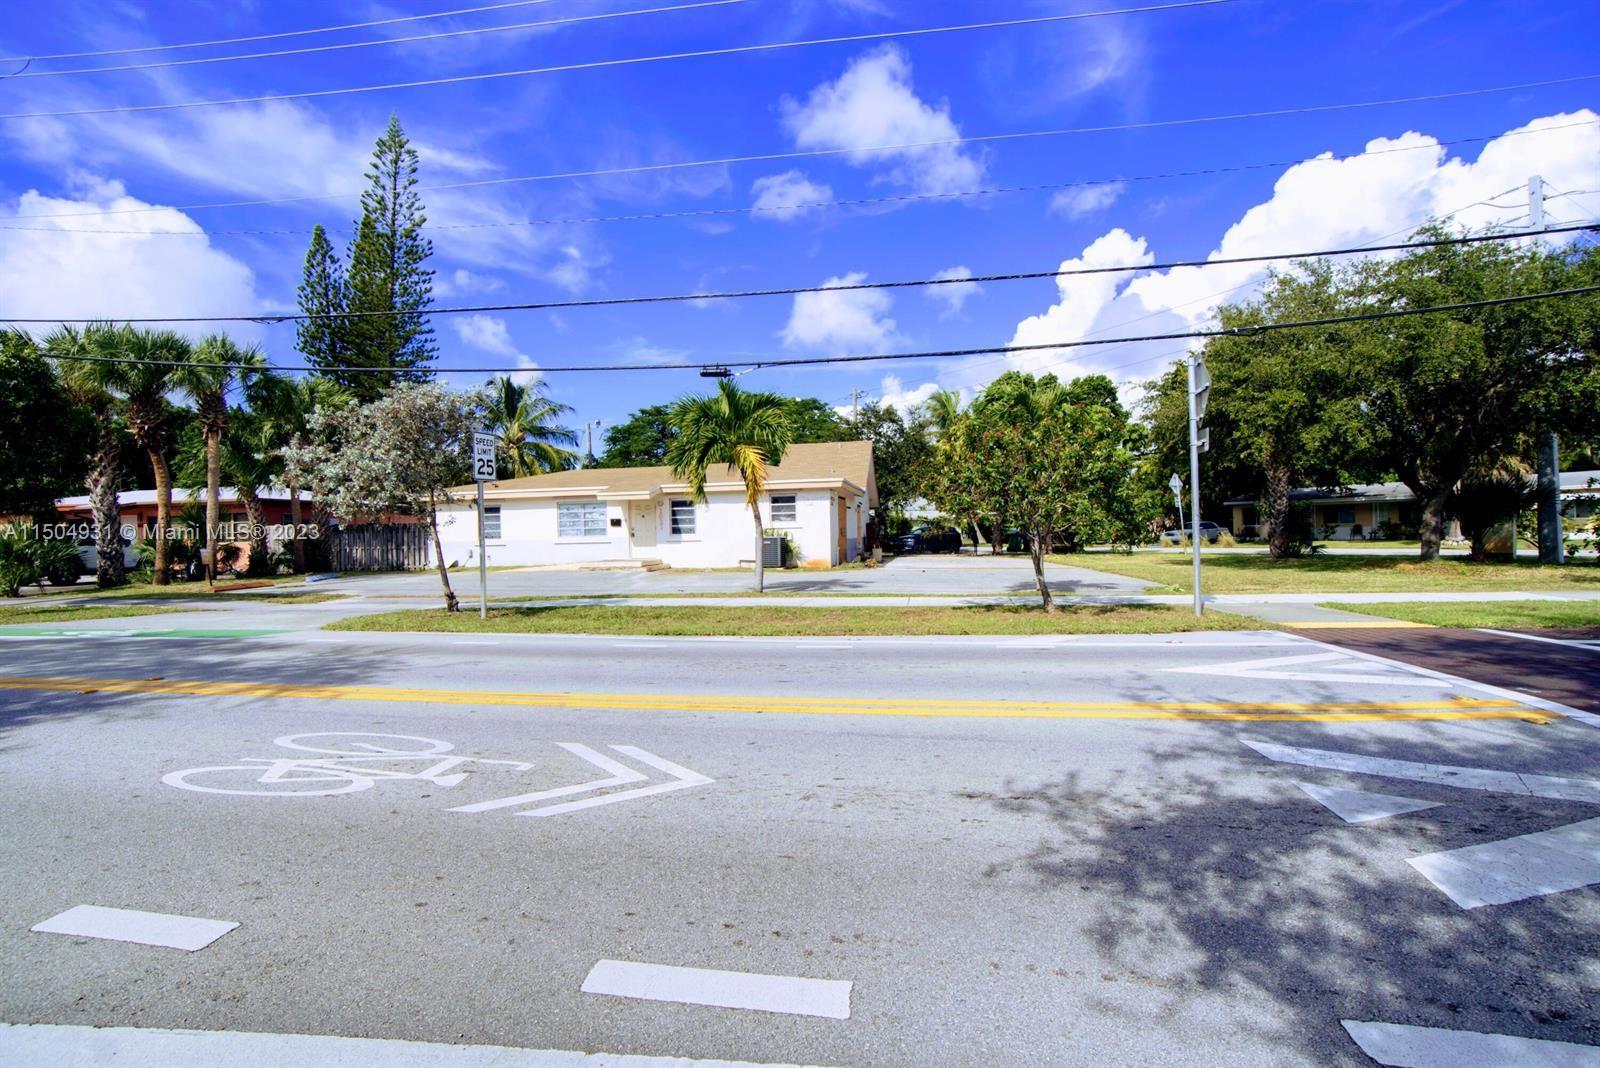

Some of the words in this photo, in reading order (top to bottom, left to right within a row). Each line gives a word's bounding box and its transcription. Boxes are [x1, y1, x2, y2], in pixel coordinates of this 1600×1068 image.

[475, 437, 493, 447] SPEED
[477, 448, 492, 456] LIMIT
[477, 458, 494, 476] 25
